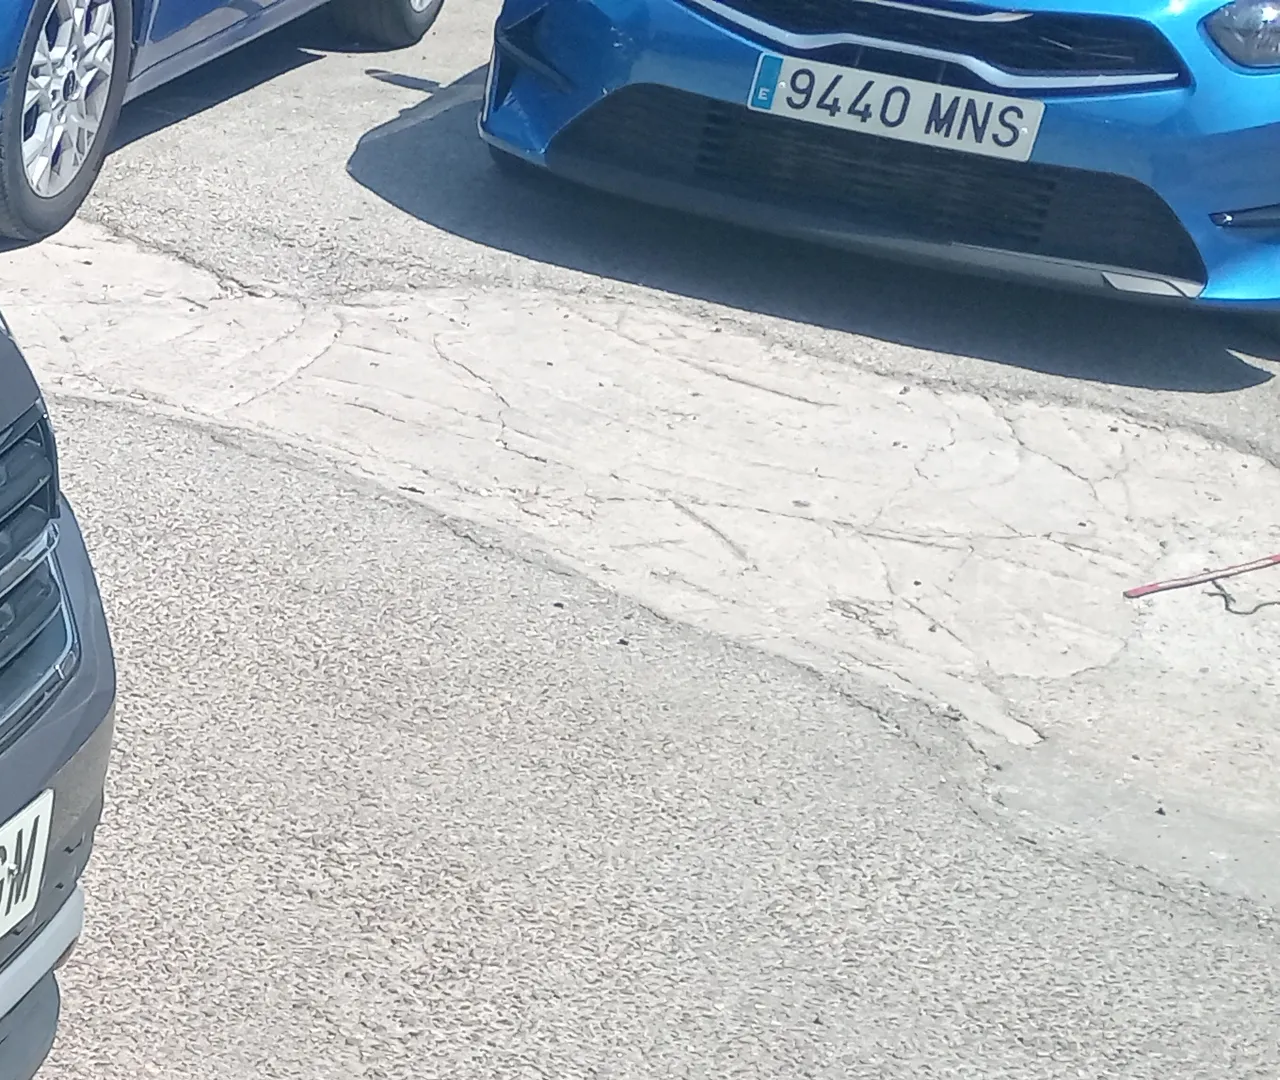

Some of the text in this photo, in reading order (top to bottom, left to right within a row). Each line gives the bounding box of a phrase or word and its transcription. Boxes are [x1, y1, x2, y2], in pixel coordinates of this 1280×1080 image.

[757, 86, 770, 101] E
[785, 67, 1025, 149] 9440 MNS
